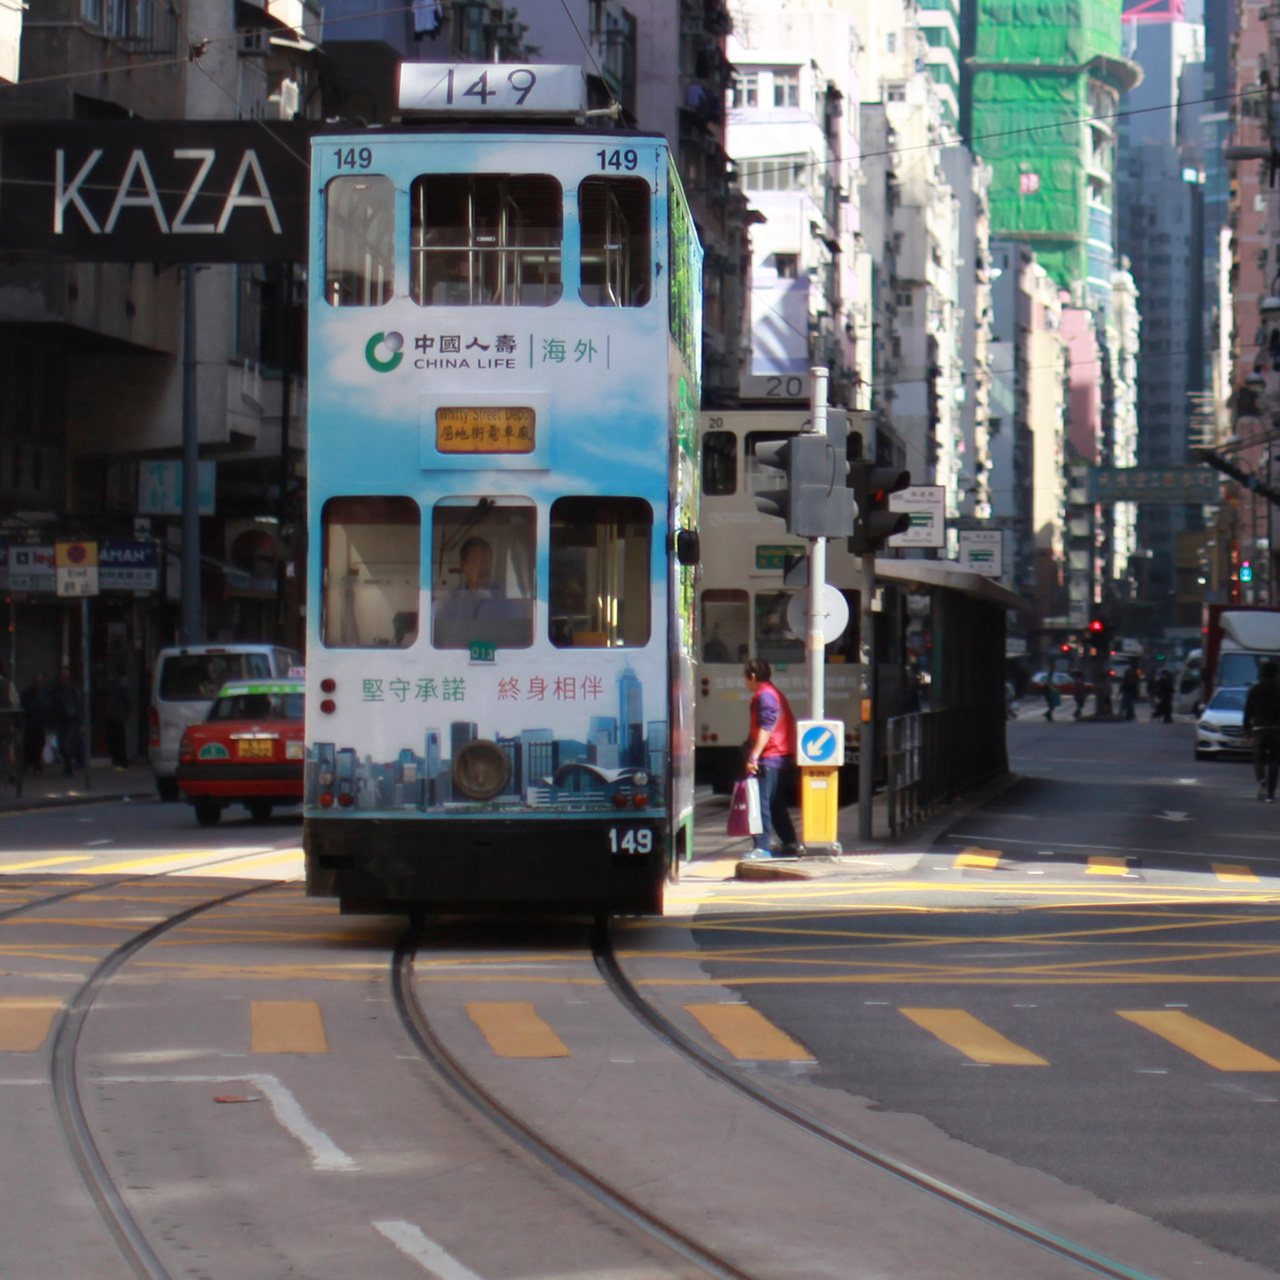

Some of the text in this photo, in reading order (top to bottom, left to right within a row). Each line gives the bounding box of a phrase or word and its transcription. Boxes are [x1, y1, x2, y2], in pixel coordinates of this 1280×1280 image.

[445, 69, 537, 106] 149
[333, 147, 373, 170] 149
[596, 149, 638, 171] 149
[52, 148, 283, 234] KAZA
[414, 333, 517, 355] 中國人壽
[542, 338, 598, 364] 海外
[414, 358, 516, 370] CHINA LIFE
[766, 376, 803, 398] 20
[440, 425, 533, 443] 屈地街電車廠
[709, 418, 723, 429] 20
[361, 675, 604, 703] 堅守承諾 終身相伴
[608, 828, 652, 855] 149
